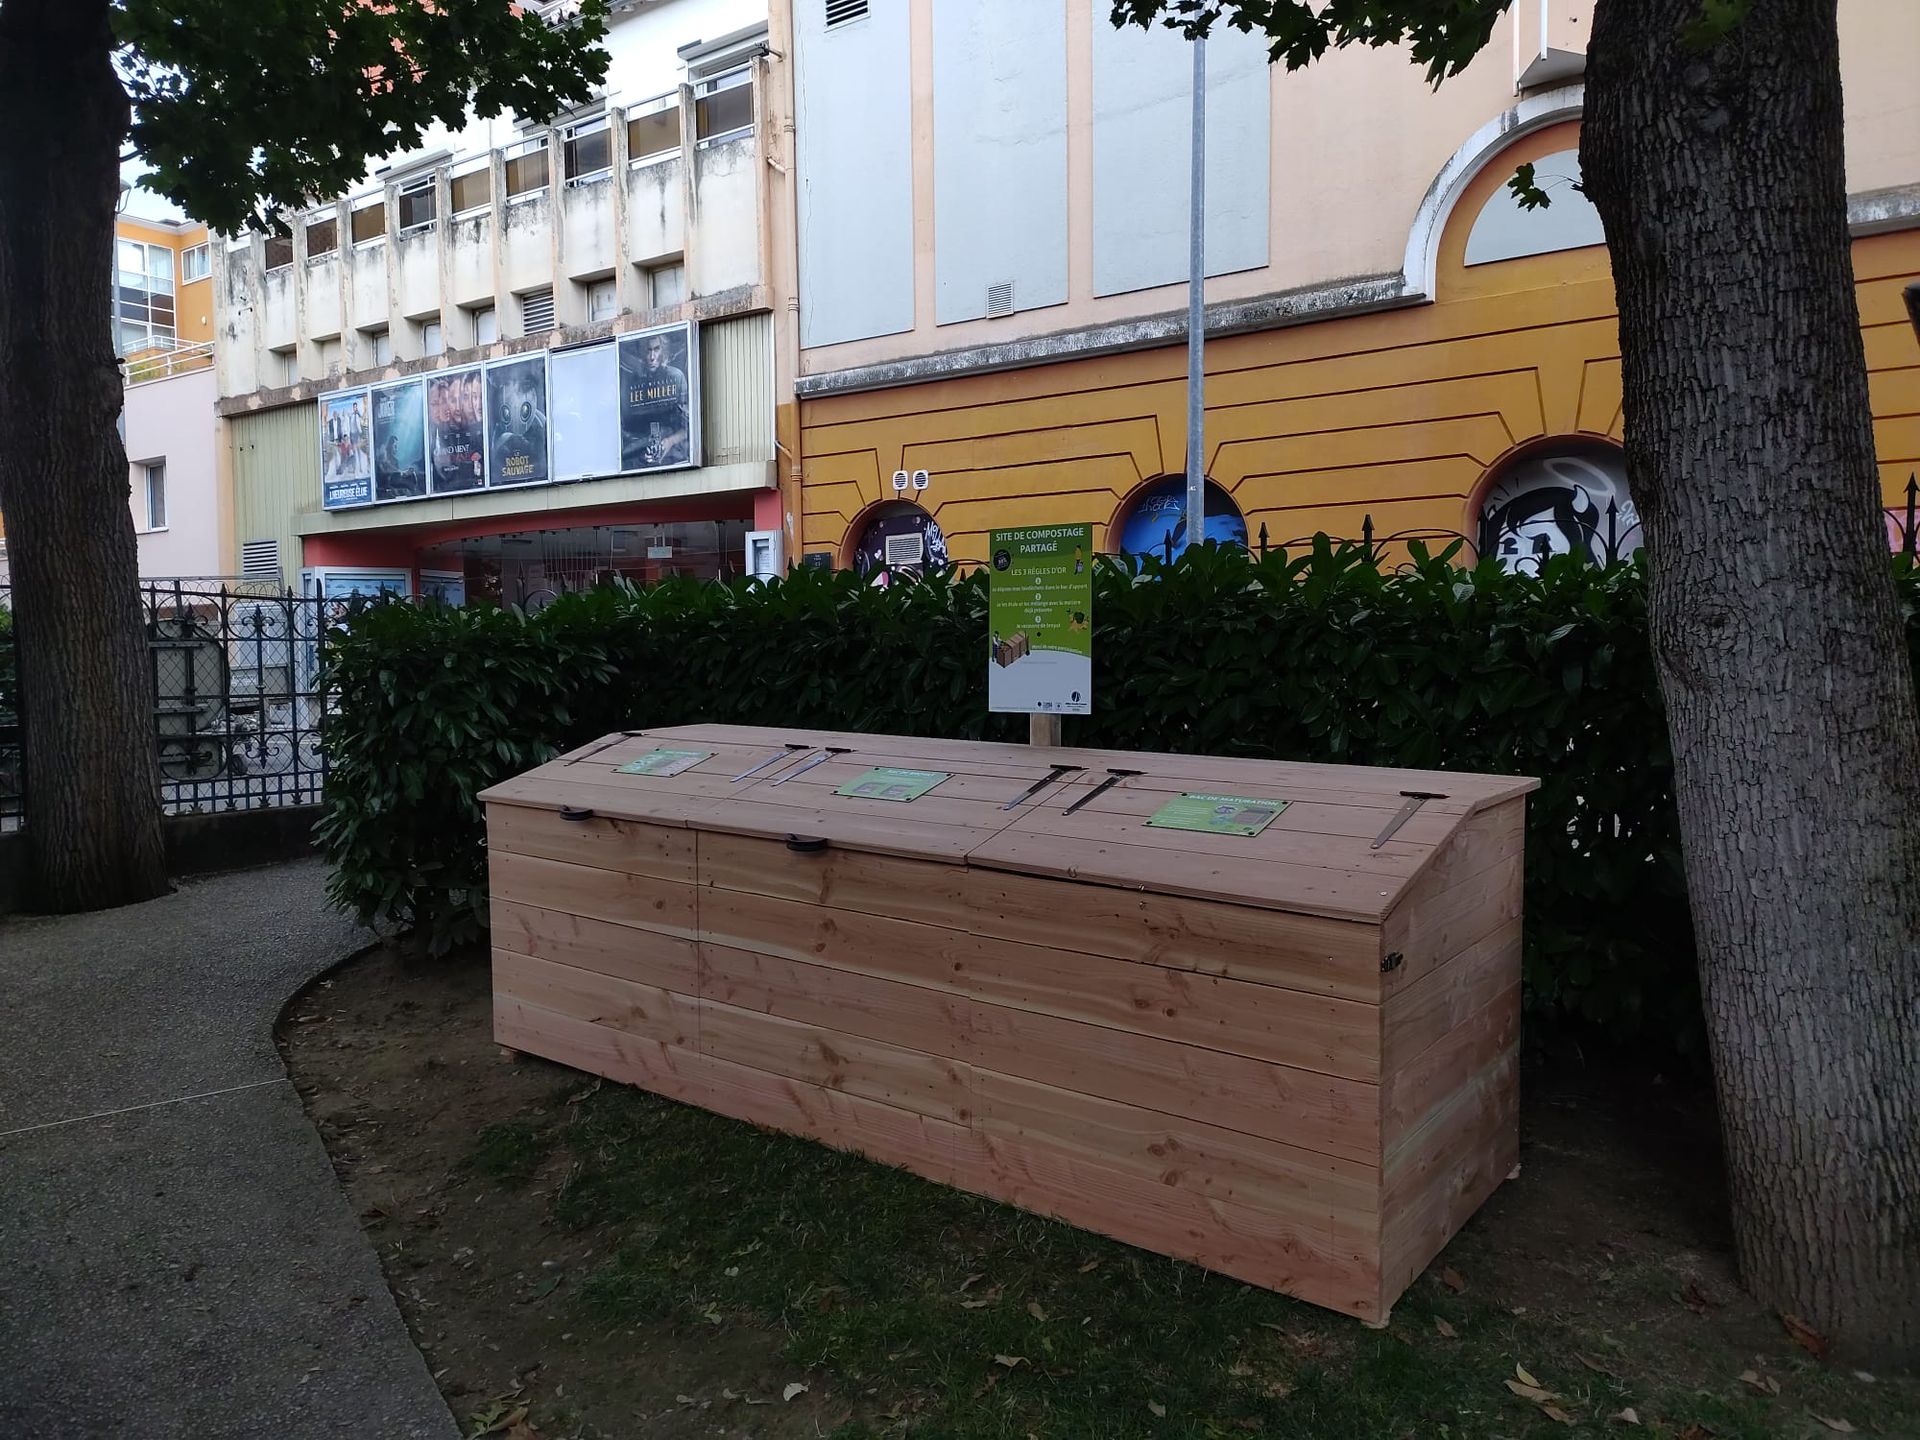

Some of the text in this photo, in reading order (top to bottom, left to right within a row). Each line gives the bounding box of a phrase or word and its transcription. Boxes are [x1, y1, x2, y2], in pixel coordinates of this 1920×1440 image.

[630, 384, 677, 403] LEE MILLER
[506, 455, 530, 467] ROBOT
[502, 464, 534, 477] SAUVAGE
[996, 527, 1084, 542] SITE DE COMPOSTAGE
[1020, 541, 1058, 553] PARTAGÉ
[1011, 568, 1021, 576] LES
[1051, 566, 1067, 574] D'OR
